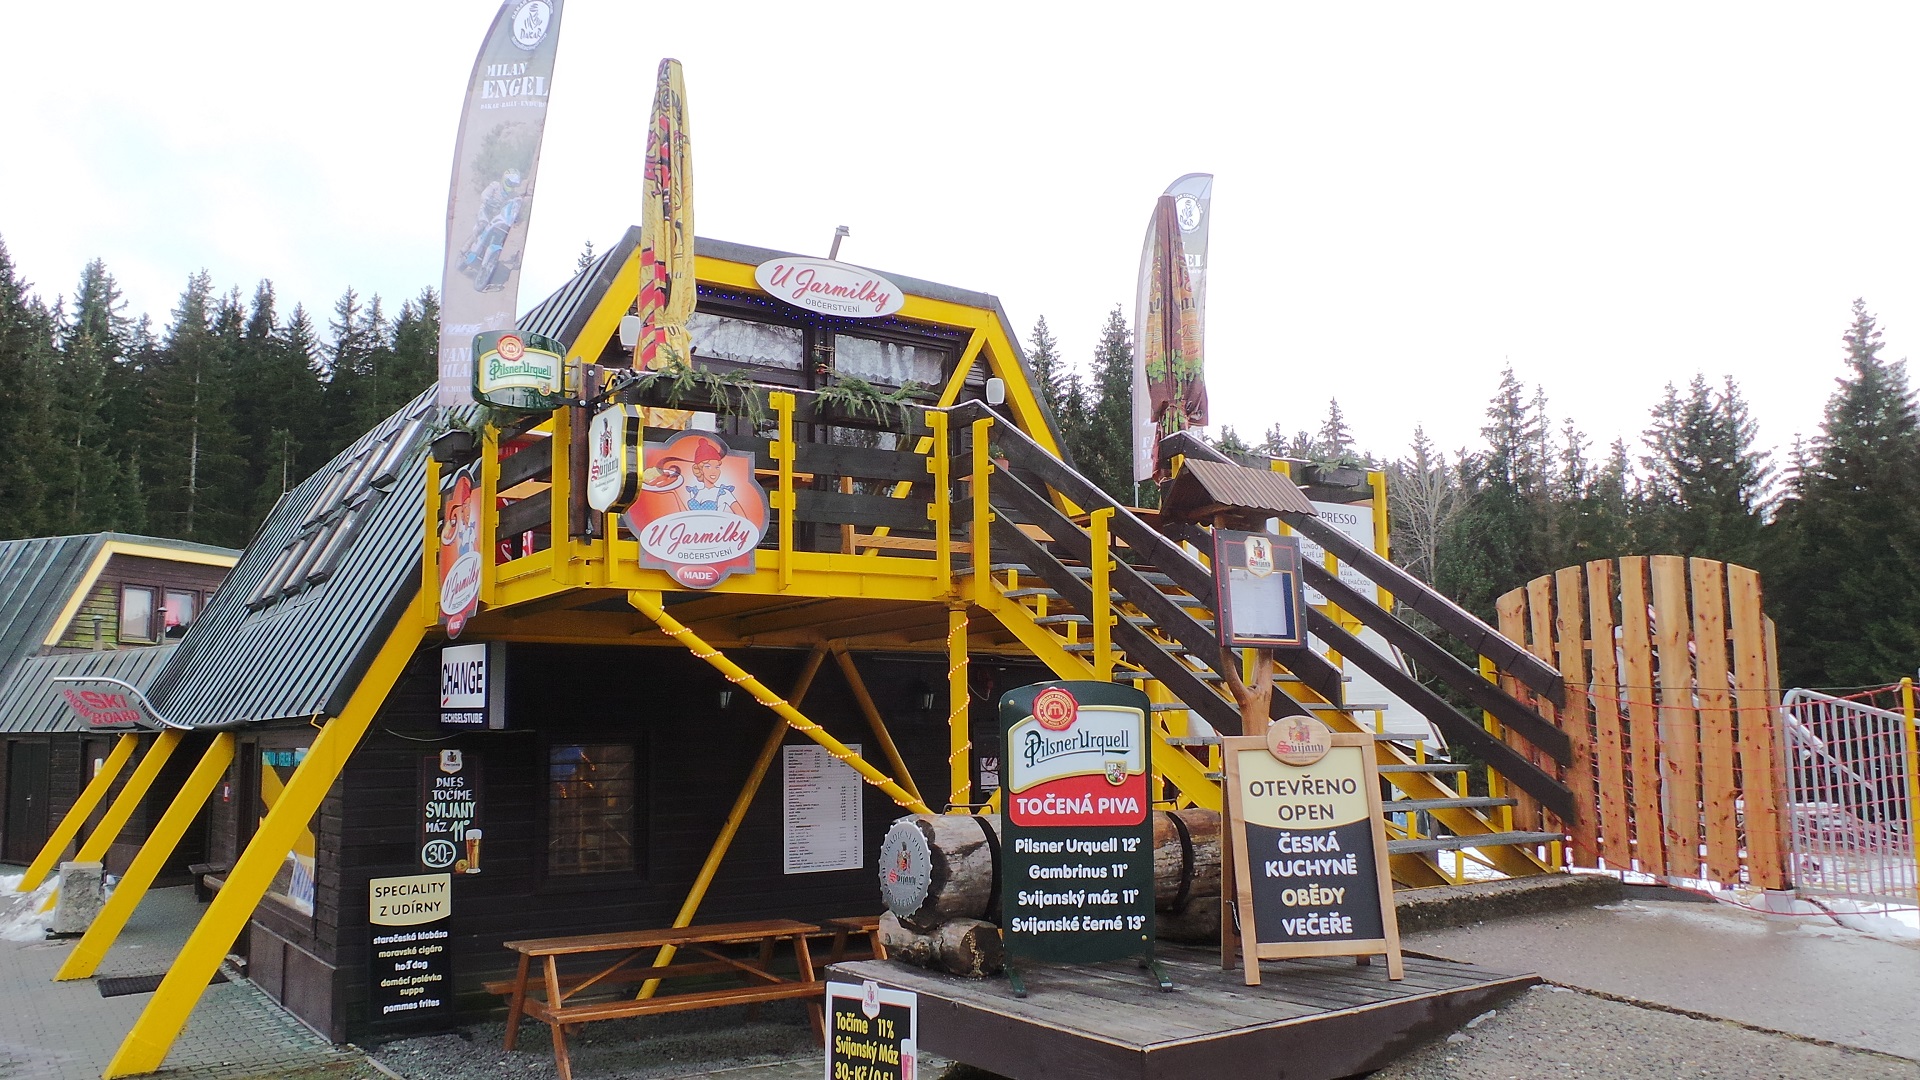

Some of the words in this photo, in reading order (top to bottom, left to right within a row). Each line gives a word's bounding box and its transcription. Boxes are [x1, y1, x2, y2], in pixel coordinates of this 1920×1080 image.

[486, 62, 528, 77] MILAN
[480, 76, 548, 99] ENGEL
[770, 264, 794, 288] U
[791, 268, 891, 313] Jarmilky
[805, 298, 860, 313] OBČERSTVENÍ
[489, 358, 523, 381] Pilsner
[522, 360, 552, 379] Urquell
[1321, 511, 1357, 525] PRESSO
[648, 524, 668, 547] U
[667, 520, 750, 554] Jarmilky
[677, 547, 733, 559] OBČERSTVENÍ
[684, 571, 713, 580] MADE
[442, 660, 484, 696] CHANGE
[80, 690, 128, 710] SKI
[440, 712, 483, 724] WECHSELSTUBE
[1024, 730, 1079, 768] Pilsner
[1077, 728, 1129, 756] Urquell
[435, 777, 464, 788] DNES
[1249, 774, 1357, 798] OTEVŘENO
[431, 787, 473, 801] TOČÍME
[425, 801, 476, 819] SVIJANY
[1016, 792, 1094, 815] TOČENÁ
[1098, 797, 1139, 815] PIVA
[1278, 804, 1334, 821] OPEN
[426, 819, 447, 833] MÁZ
[1015, 838, 1064, 853] Pilsner
[1065, 837, 1118, 856] Urquell
[1121, 837, 1141, 852] 12°
[1278, 830, 1341, 854] ČESKÁ
[1028, 863, 1108, 879] Gambrinus
[1111, 863, 1129, 878] 11°
[1265, 853, 1358, 878] KUCHYNĚ
[375, 881, 446, 898] SPECIALITY
[1018, 889, 1086, 909] Svijanský
[1087, 888, 1119, 905] máz
[1122, 888, 1139, 904] 11°
[1281, 883, 1346, 907] OBĚDY
[380, 905, 388, 917] Z
[391, 899, 442, 916] UDÍRNY
[1011, 916, 1080, 936] Svijanské
[1082, 915, 1123, 931] černé
[1126, 915, 1146, 931] 13°
[1281, 911, 1354, 936] VEČEŘE
[373, 932, 417, 945] staročeská
[417, 930, 448, 940] klobása
[418, 945, 443, 955] cigáro
[412, 960, 428, 970] dog
[380, 975, 411, 987] domácí
[411, 973, 442, 986] polévka
[400, 987, 425, 997] suppe
[383, 1002, 418, 1015] pommes
[419, 998, 440, 1009] frites
[835, 1011, 869, 1035] Točíme
[835, 1035, 878, 1065] Svijanský
[878, 1043, 899, 1066] Máz
